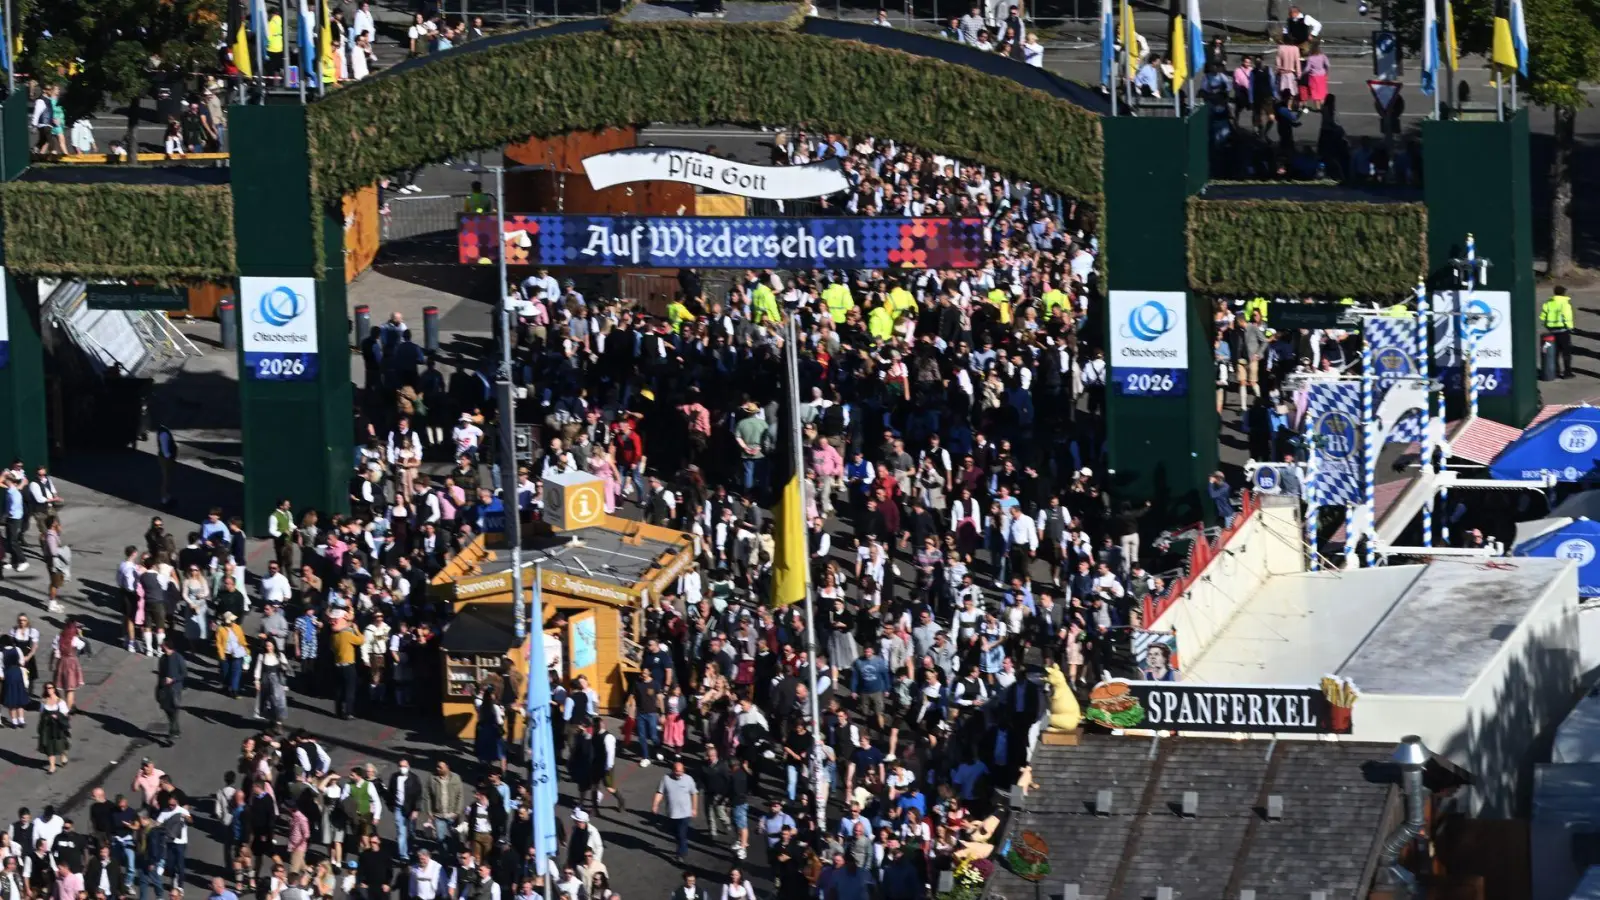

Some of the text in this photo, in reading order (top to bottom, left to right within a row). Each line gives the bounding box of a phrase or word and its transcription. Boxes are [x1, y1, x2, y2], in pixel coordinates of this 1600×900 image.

[669, 154, 767, 191] Pfüa Gott
[581, 224, 857, 264] Auf Wiedersehen
[252, 331, 309, 344] Oktoberfest
[1120, 346, 1178, 359] Oktoberfest
[259, 358, 305, 375] 2026
[1127, 373, 1174, 391] 2026
[1451, 373, 1498, 391] 226
[562, 577, 628, 601] Information
[1147, 690, 1317, 727] SPANFERKEL
